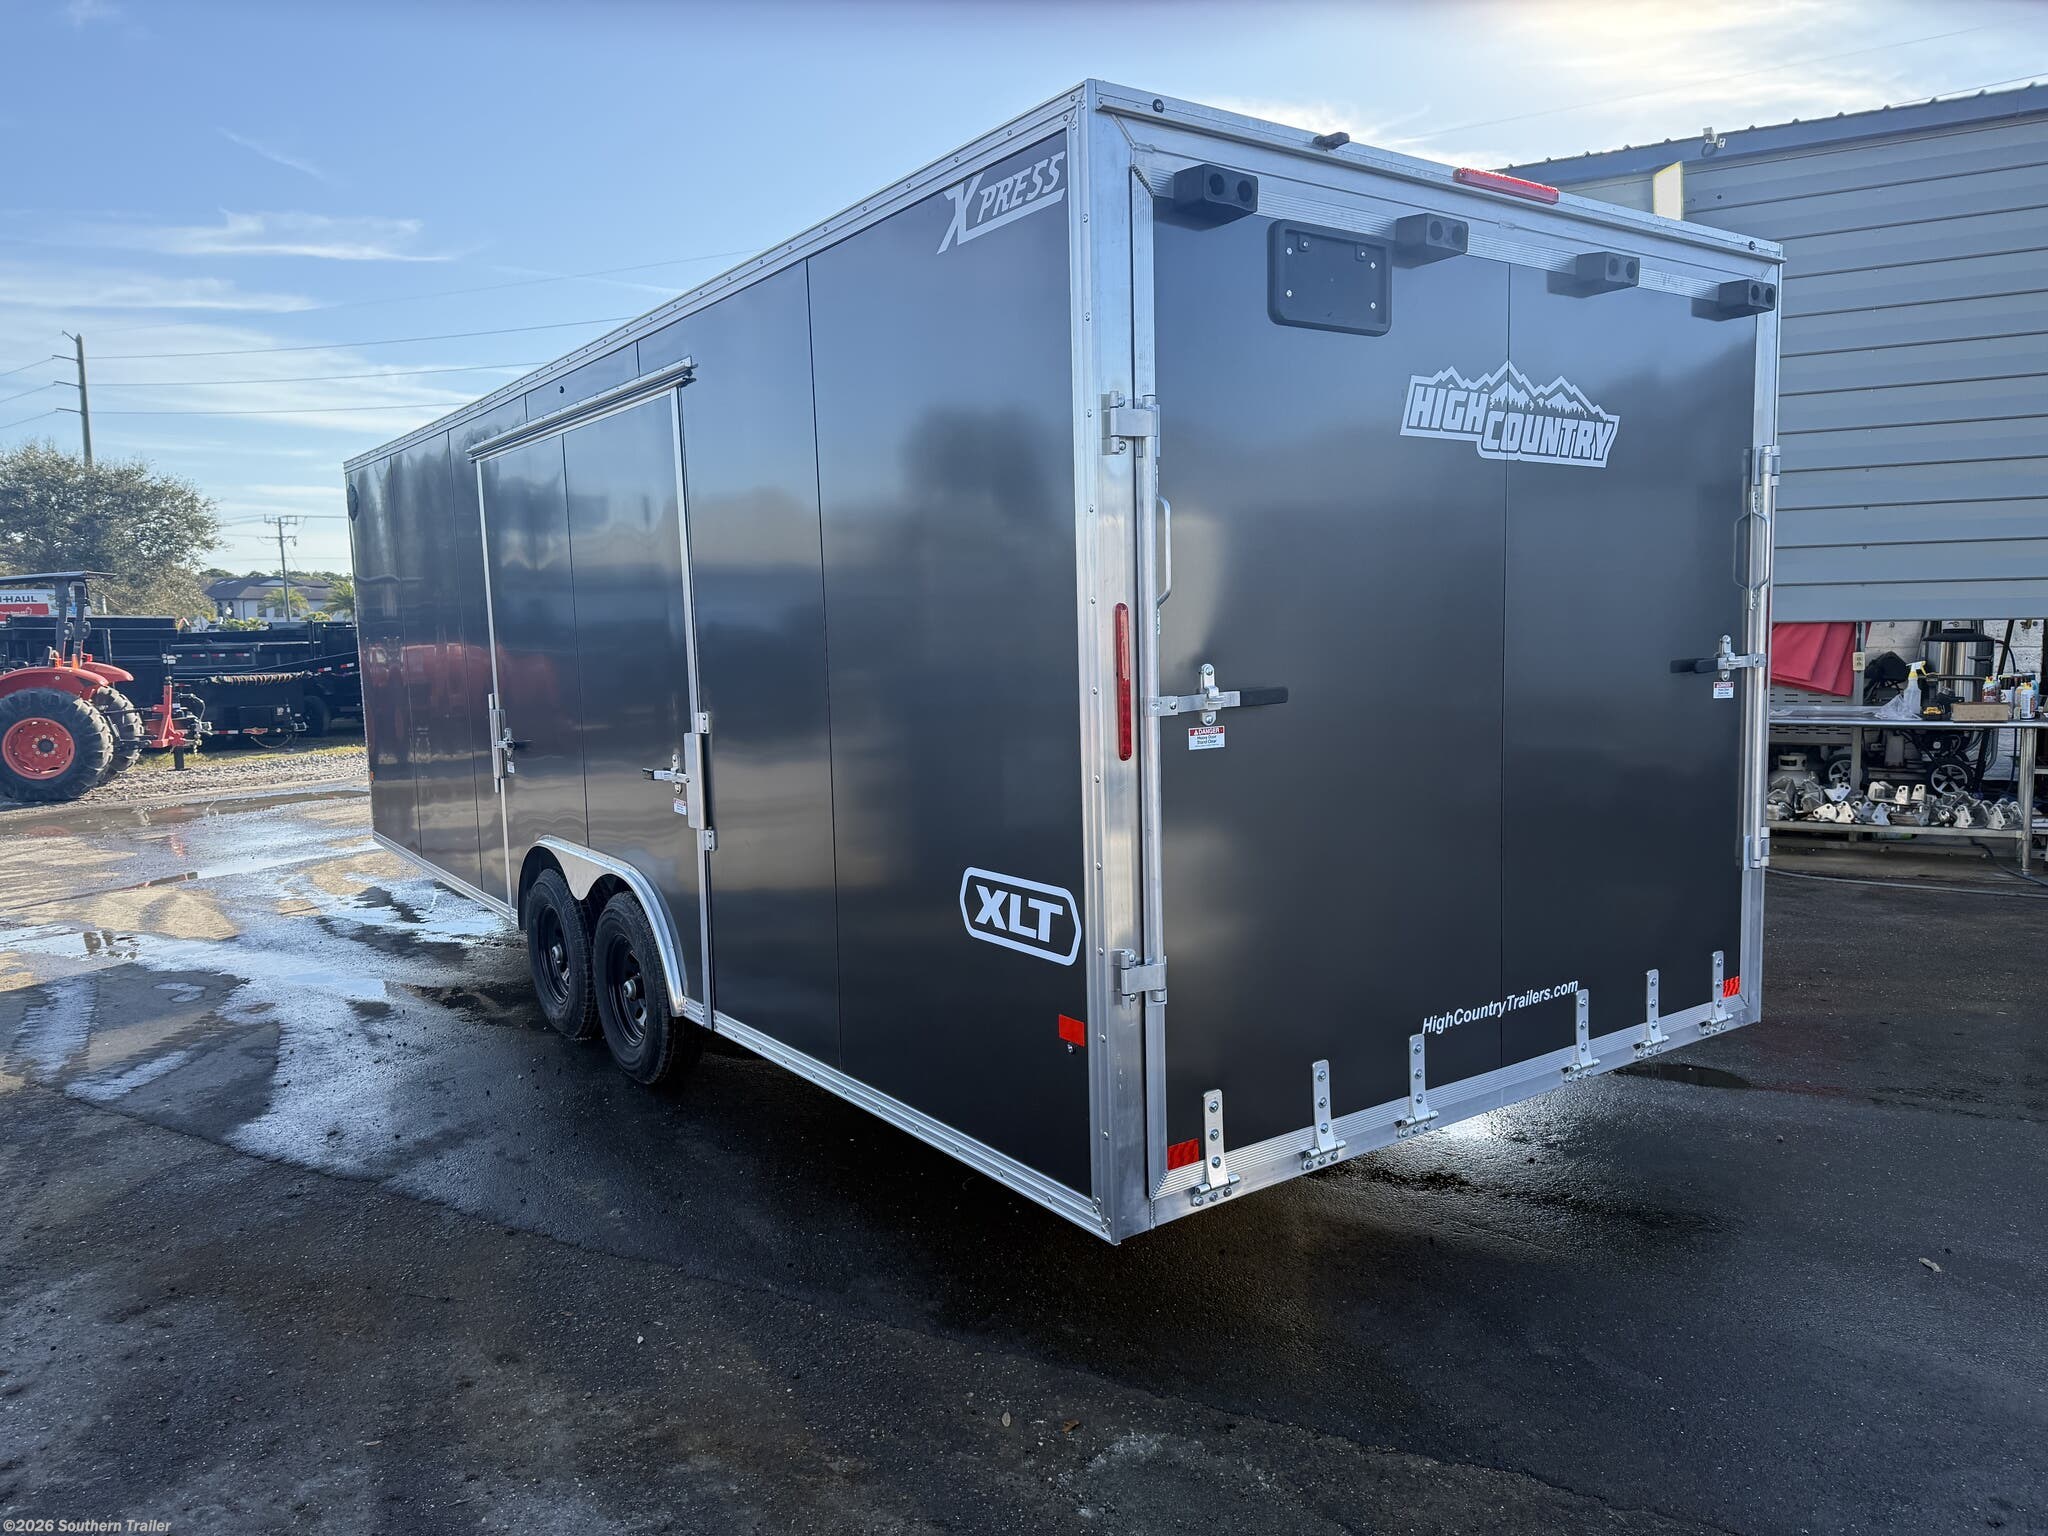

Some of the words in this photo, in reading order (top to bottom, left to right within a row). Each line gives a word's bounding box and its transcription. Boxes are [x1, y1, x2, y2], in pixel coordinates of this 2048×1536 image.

[936, 151, 1066, 255] XPRESS
[1407, 385, 1489, 433] HIGH
[1482, 410, 1613, 460] COUNTRY
[0, 595, 38, 603] -HAUL
[974, 884, 1064, 943] XLT
[1422, 979, 1579, 1034] HighCountryTrailers.com
